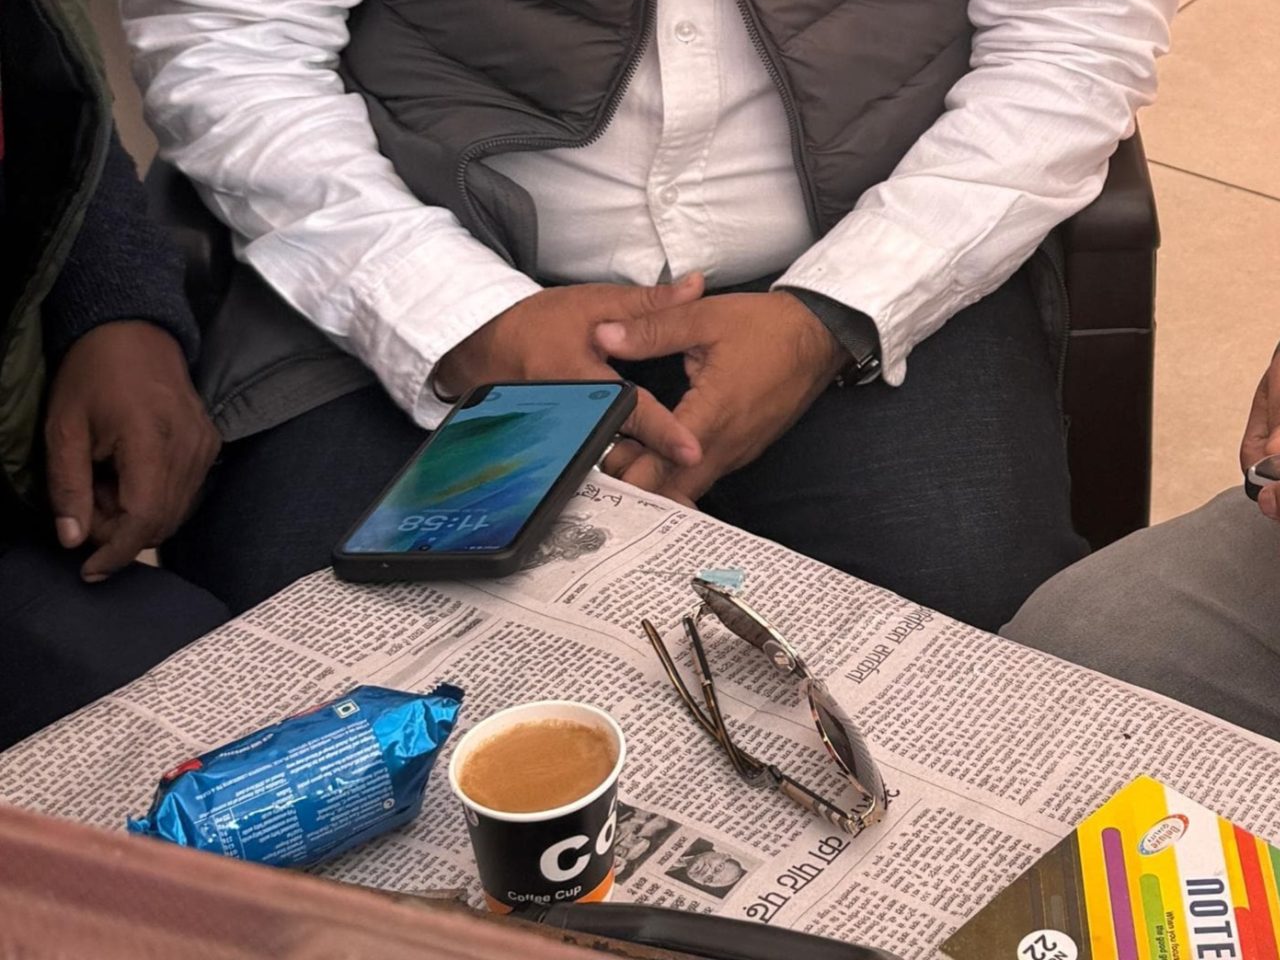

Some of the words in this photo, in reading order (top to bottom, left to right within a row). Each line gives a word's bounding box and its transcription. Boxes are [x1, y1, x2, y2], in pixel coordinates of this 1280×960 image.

[397, 507, 491, 532] 11:58
[846, 644, 893, 684] सतर्कता
[1147, 823, 1169, 843] QUALITY
[809, 834, 851, 870] का
[777, 863, 824, 895] पाठ
[507, 890, 551, 904] Coffee
[554, 884, 582, 901] Cup
[1166, 911, 1175, 930] When
[1167, 931, 1176, 943] you
